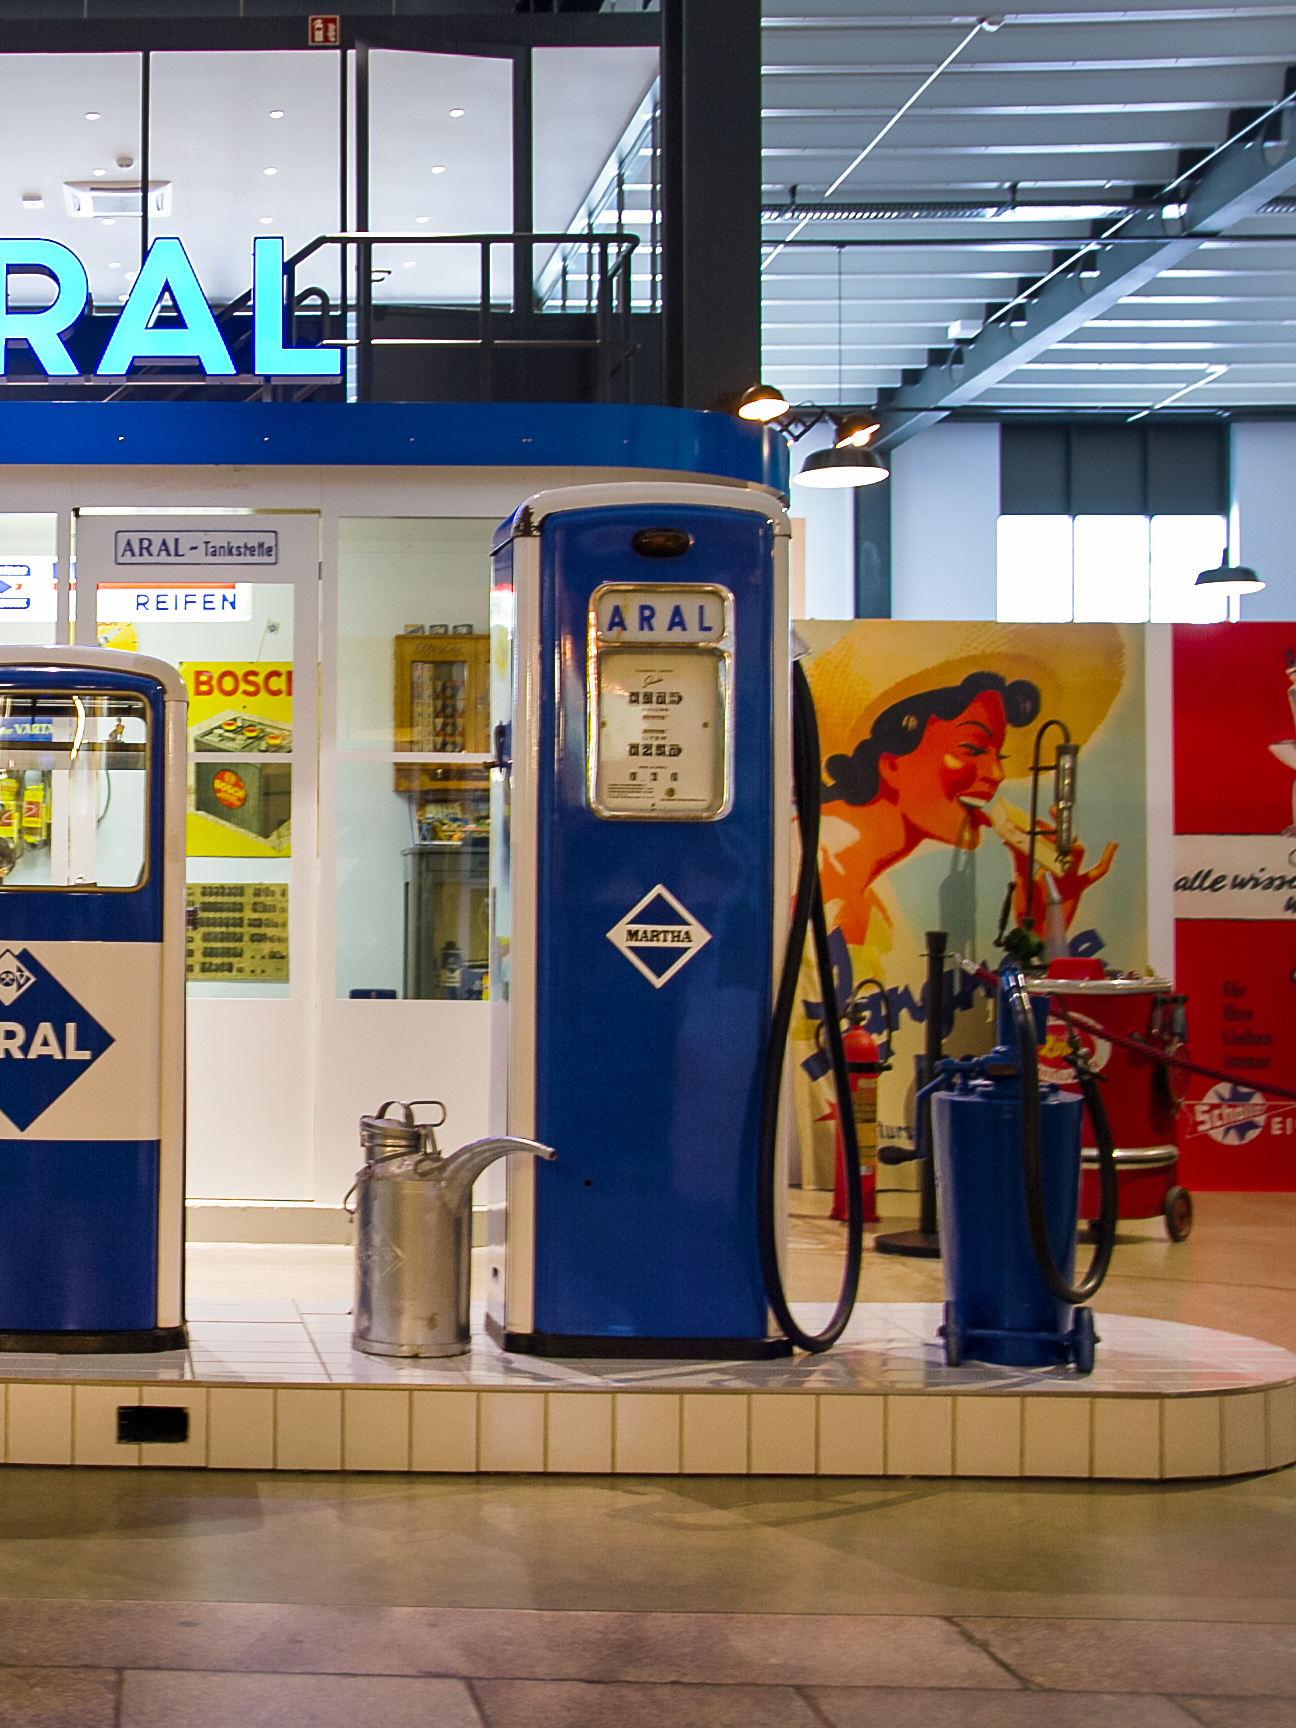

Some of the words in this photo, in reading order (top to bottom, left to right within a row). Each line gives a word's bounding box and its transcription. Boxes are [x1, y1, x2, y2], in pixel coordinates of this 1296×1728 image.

[120, 537, 185, 558] ARAL
[203, 540, 275, 558] Tankstelle
[136, 592, 237, 611] REIFEN
[606, 604, 714, 632] ARAL
[1172, 867, 1228, 893] alle
[625, 929, 693, 943] MARTHA
